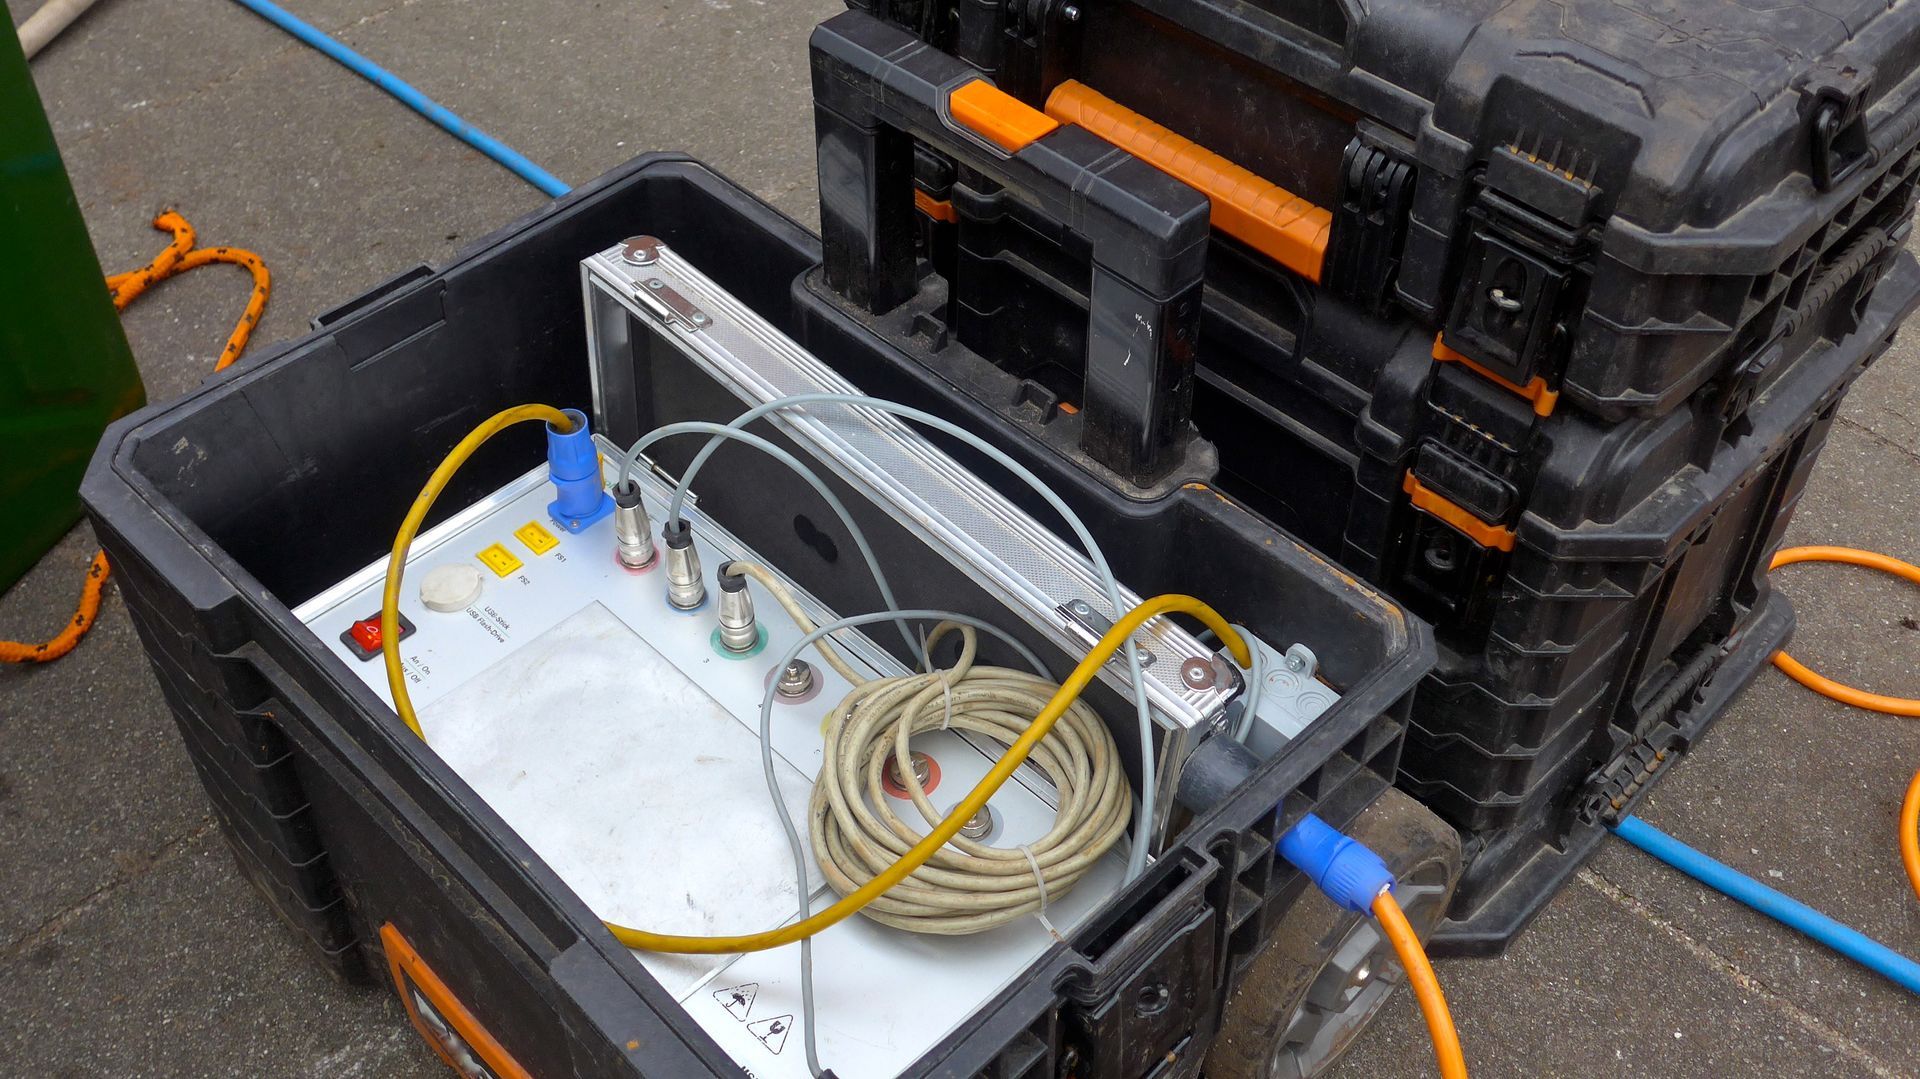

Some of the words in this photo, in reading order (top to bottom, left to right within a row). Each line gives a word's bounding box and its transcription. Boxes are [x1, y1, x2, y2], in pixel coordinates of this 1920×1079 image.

[554, 552, 567, 563] FS1
[518, 575, 531, 585] FS2
[465, 607, 480, 619] USB
[477, 616, 505, 643] Flash-Drive
[484, 605, 510, 630] USB-Stick
